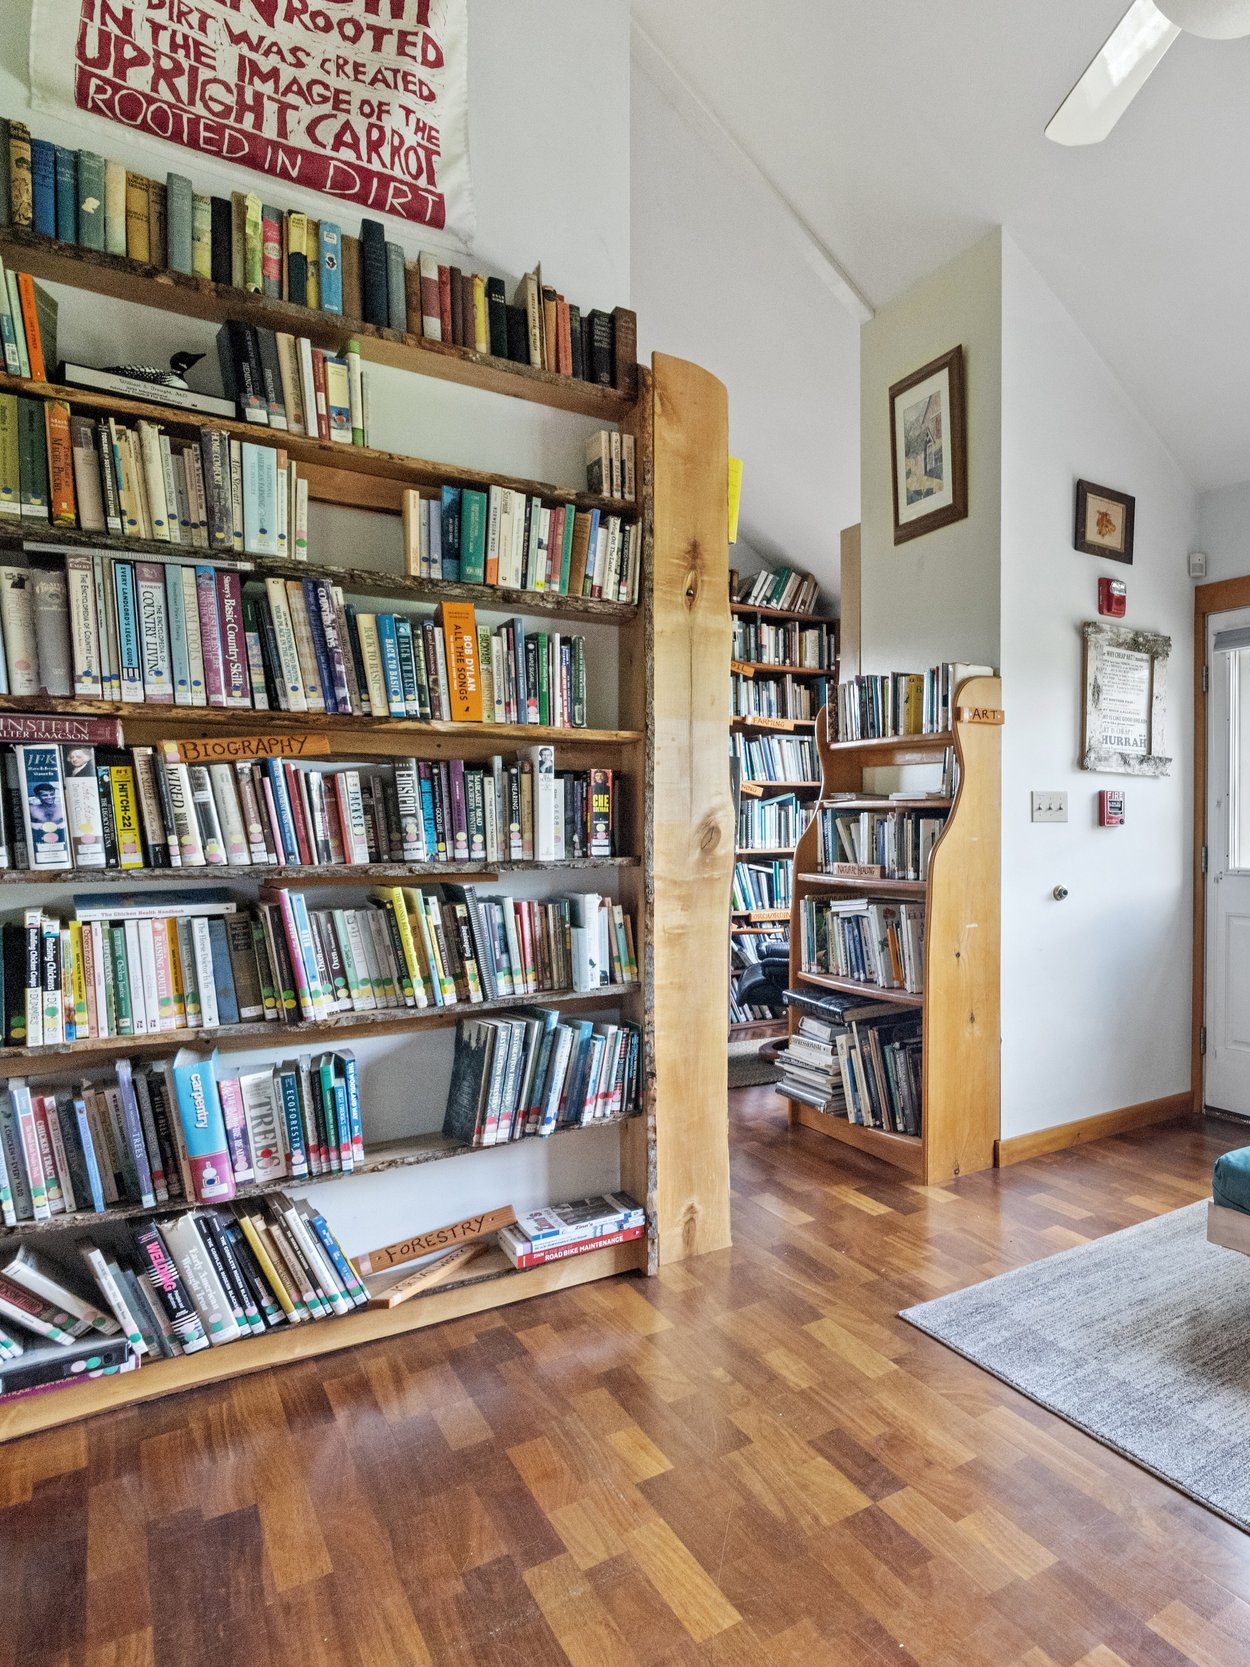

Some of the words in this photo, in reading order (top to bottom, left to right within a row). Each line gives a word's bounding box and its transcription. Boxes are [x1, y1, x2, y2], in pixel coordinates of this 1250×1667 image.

[283, 0, 444, 68] ROOTED
[224, 18, 313, 69] WAS
[320, 54, 437, 103] CREATED
[81, 0, 136, 40] IN
[146, 17, 217, 71] THE
[237, 53, 352, 114] IMAGE
[359, 99, 392, 122] OF
[398, 104, 441, 149] THE
[75, 18, 300, 140] UPRIGHT
[305, 113, 442, 188] CARROT
[88, 80, 249, 157] ROOTED
[265, 146, 302, 178] IN
[322, 160, 443, 222] DIRT
[101, 432, 109, 454] TOOLBOX
[104, 458, 113, 489] SUSTAINABLE
[231, 457, 240, 475] Alex
[233, 476, 241, 506] Stewart
[222, 575, 231, 599] Storey's
[81, 585, 90, 622] ENCYCLOPEDIA
[122, 588, 131, 626] LANDLORD'S
[143, 590, 156, 640] COUNTRY
[225, 598, 236, 623] Basic
[84, 630, 92, 655] COUNTRY
[157, 616, 165, 655] ENCYCLOPEDIA
[187, 627, 199, 661] TOOLS
[226, 623, 240, 662] Country
[363, 626, 375, 648] BACK
[454, 624, 464, 642] ALL
[463, 635, 473, 655] BOB
[146, 641, 158, 677] LIVING
[368, 650, 376, 661] TO
[385, 638, 395, 658] BACK
[456, 645, 465, 664] THE
[480, 633, 491, 665] BACKYARD
[388, 659, 396, 670] TO
[466, 657, 476, 692] DYLAN
[731, 662, 747, 673] OIL
[458, 667, 468, 701] SONGS
[0, 717, 89, 734] INSTEIN
[753, 718, 785, 728] FARMING
[972, 708, 998, 720] ART
[0, 730, 29, 739] ALTER
[34, 731, 90, 741] ISAACSON
[180, 736, 307, 760] BIOGRAPHY
[27, 752, 58, 766] JFK
[167, 766, 185, 809] WIRED
[396, 770, 415, 815] Einstein
[473, 774, 483, 808] MARGARET
[511, 783, 519, 811] NEARING
[592, 794, 609, 806] CHE
[1107, 791, 1124, 800] FIRE
[118, 782, 132, 828] HITCH-22
[28, 928, 37, 950] Building
[198, 922, 207, 935] The
[461, 925, 472, 957] Beekeeping
[45, 937, 56, 961] Raising
[154, 935, 165, 965] RAISING
[199, 935, 208, 953] Horse
[30, 950, 38, 971] Chicken
[115, 959, 124, 980] Chicken
[201, 953, 211, 973] Doctor
[317, 953, 326, 972] Oxen
[332, 952, 340, 970] Oxen
[30, 971, 38, 988] Coops
[48, 961, 57, 991] Chickens
[118, 980, 126, 998] Justice
[158, 968, 168, 998] POULT
[204, 981, 213, 989] In
[494, 1031, 507, 1076] RESTORATION
[508, 1028, 521, 1073] RESTORATION
[347, 1062, 355, 1074] THE
[191, 1073, 208, 1129] carpentry
[349, 1074, 357, 1107] WOODLAND
[491, 1075, 501, 1108] FORESTRY
[36, 1120, 48, 1154] CHICKEN
[132, 1133, 144, 1159] TREES
[249, 1096, 280, 1169] TREES
[5, 1129, 16, 1156] CHICKEN
[15, 1180, 23, 1198] YARD
[206, 1237, 215, 1250] THE
[219, 1235, 229, 1247] THE
[384, 1216, 485, 1263] FORESTRY
[545, 1250, 563, 1261] ROAD
[563, 1247, 579, 1257] BIKE
[580, 1235, 624, 1252] MAINTENANCE
[147, 1241, 176, 1292] WELDING
[181, 1254, 201, 1293] Wrought
[189, 1246, 202, 1268] Early
[199, 1266, 220, 1311] American
